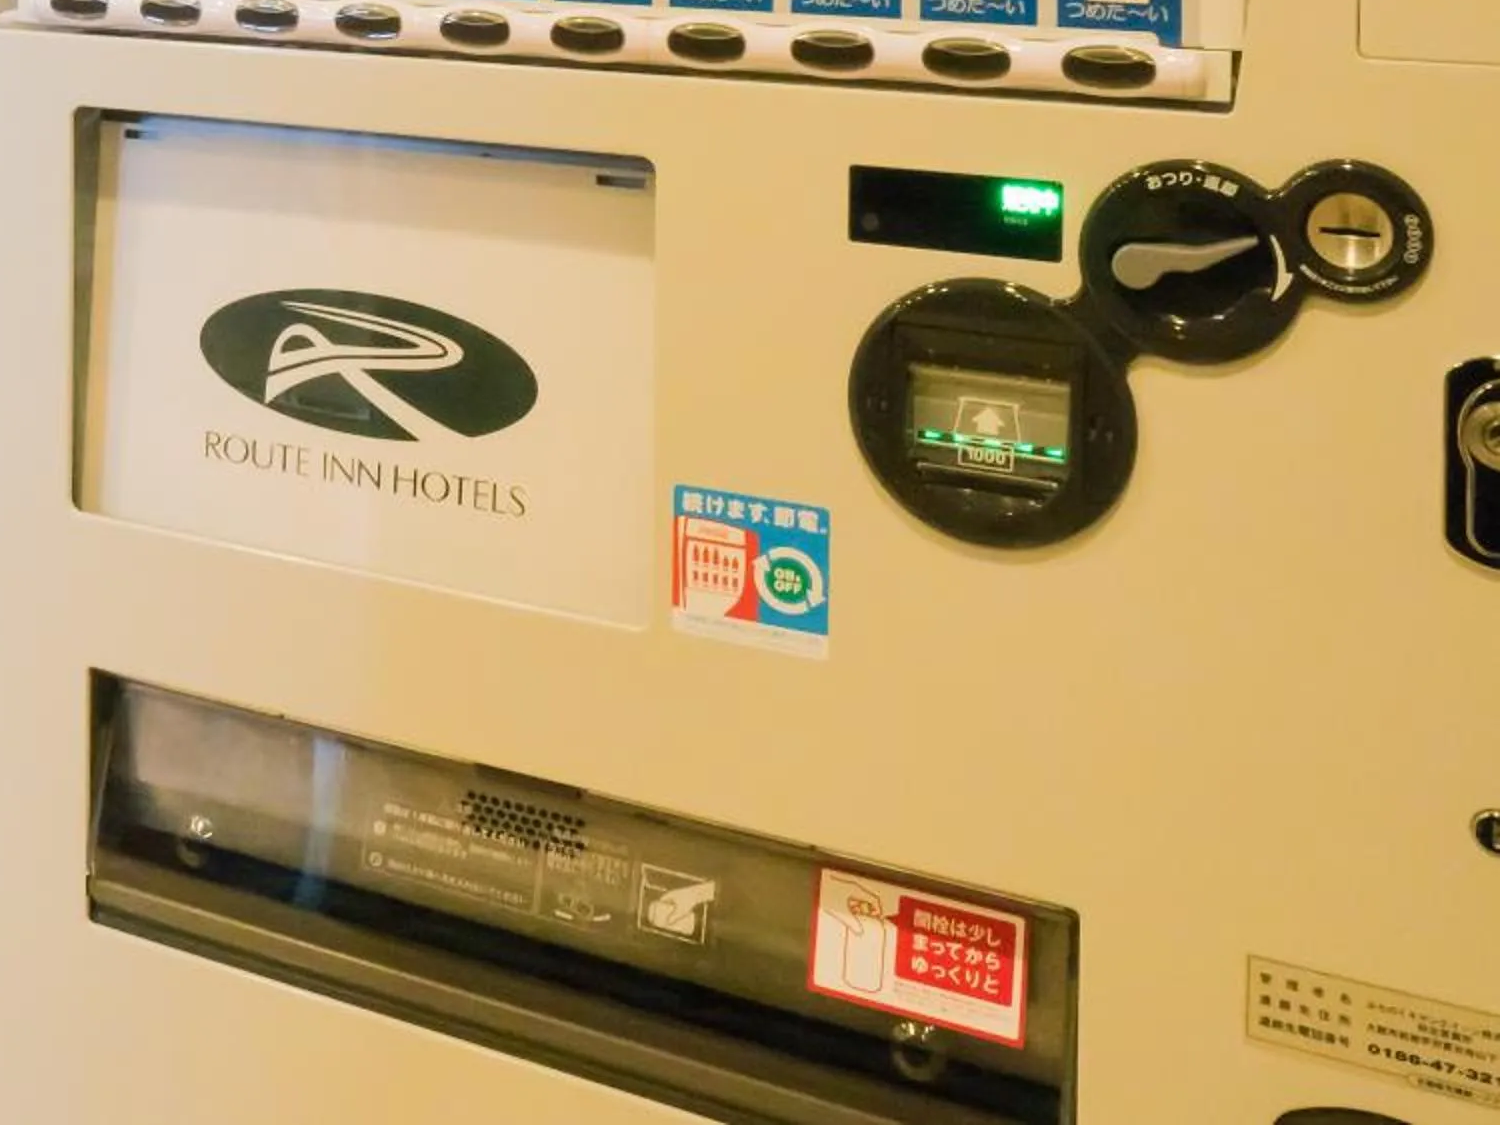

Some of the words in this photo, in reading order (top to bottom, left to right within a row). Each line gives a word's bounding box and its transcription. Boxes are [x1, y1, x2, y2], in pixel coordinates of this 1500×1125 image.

[204, 430, 310, 477] ROUTE
[322, 452, 382, 491] INN
[393, 464, 527, 517] HOTELS
[773, 578, 803, 595] OFF
[913, 907, 1001, 947] 開栓は少し
[911, 932, 1001, 972] まってから
[910, 956, 1000, 995] ゆっくりと
